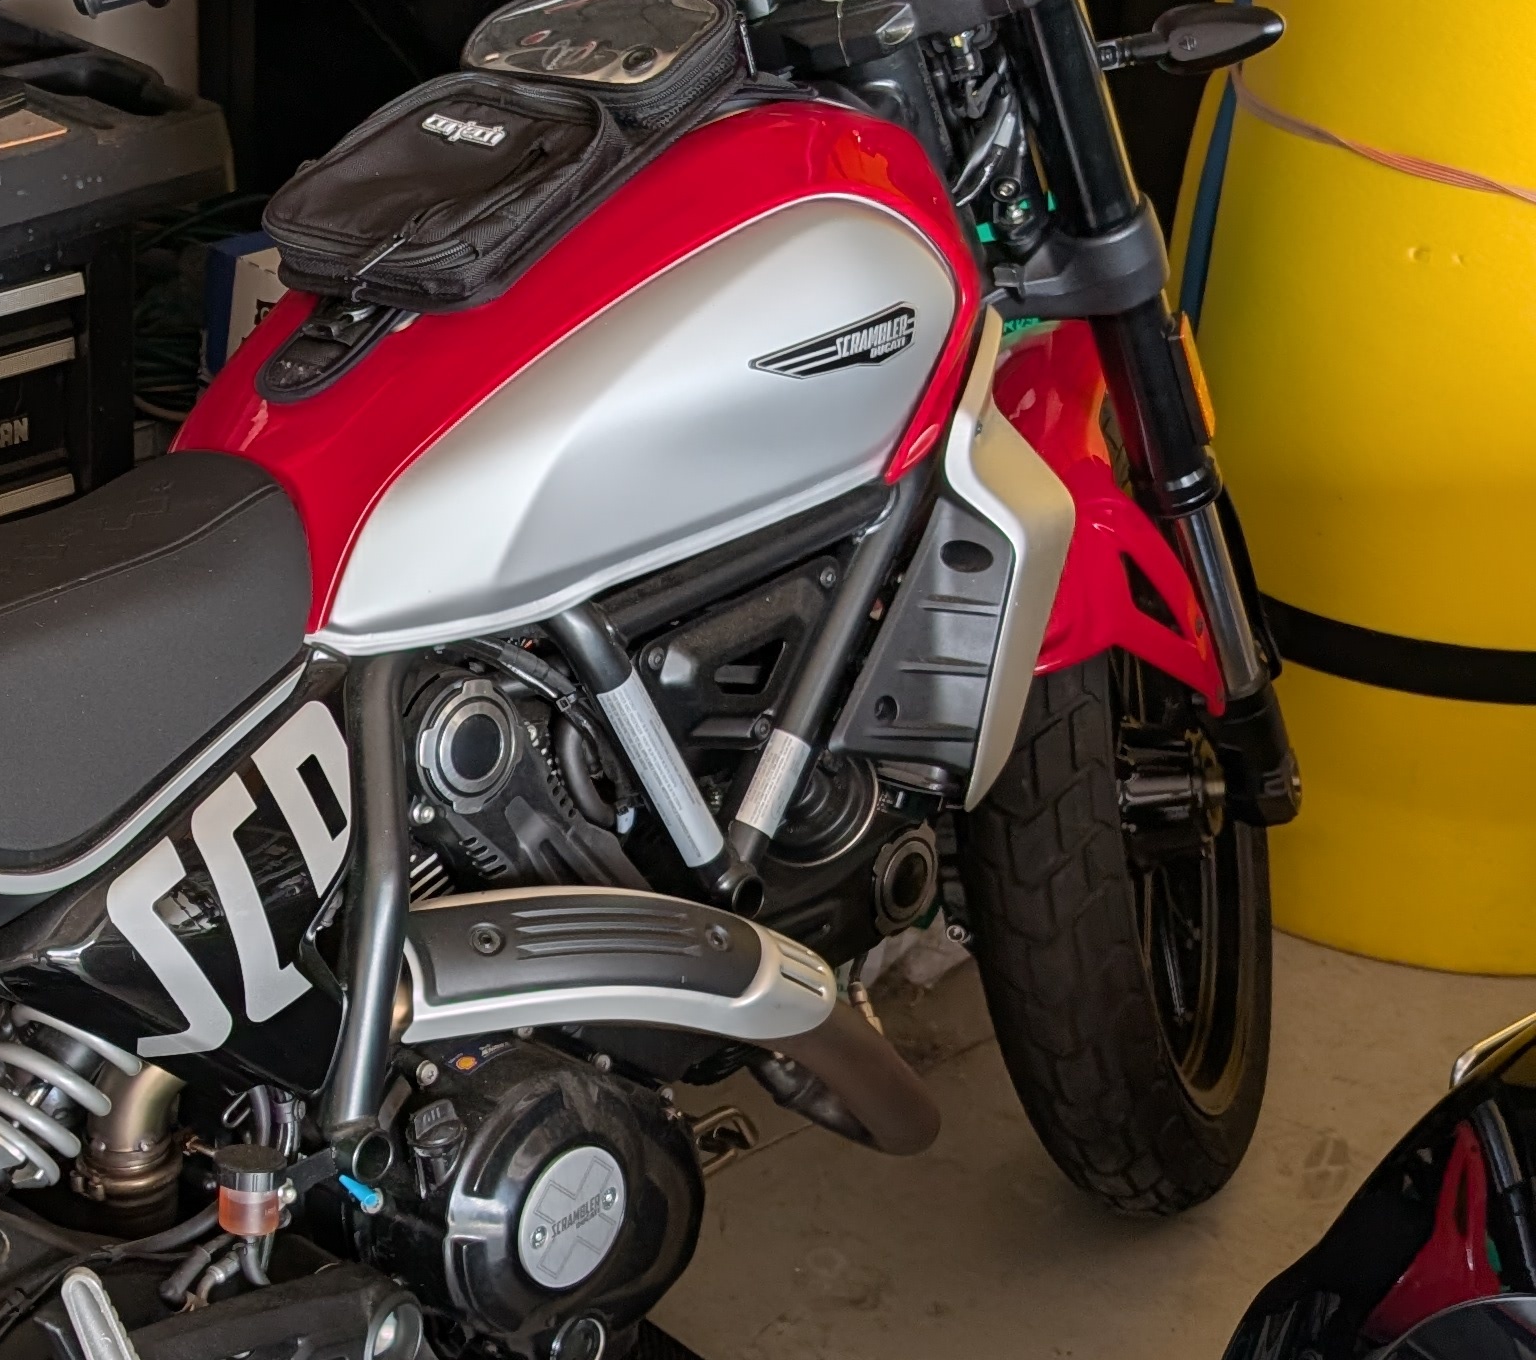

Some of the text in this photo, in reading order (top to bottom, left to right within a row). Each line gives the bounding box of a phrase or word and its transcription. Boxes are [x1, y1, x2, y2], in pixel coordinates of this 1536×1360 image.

[836, 314, 908, 358] SCRAMBLER
[870, 337, 906, 359] DUCATI
[551, 1193, 601, 1238] SCRAMBLER
